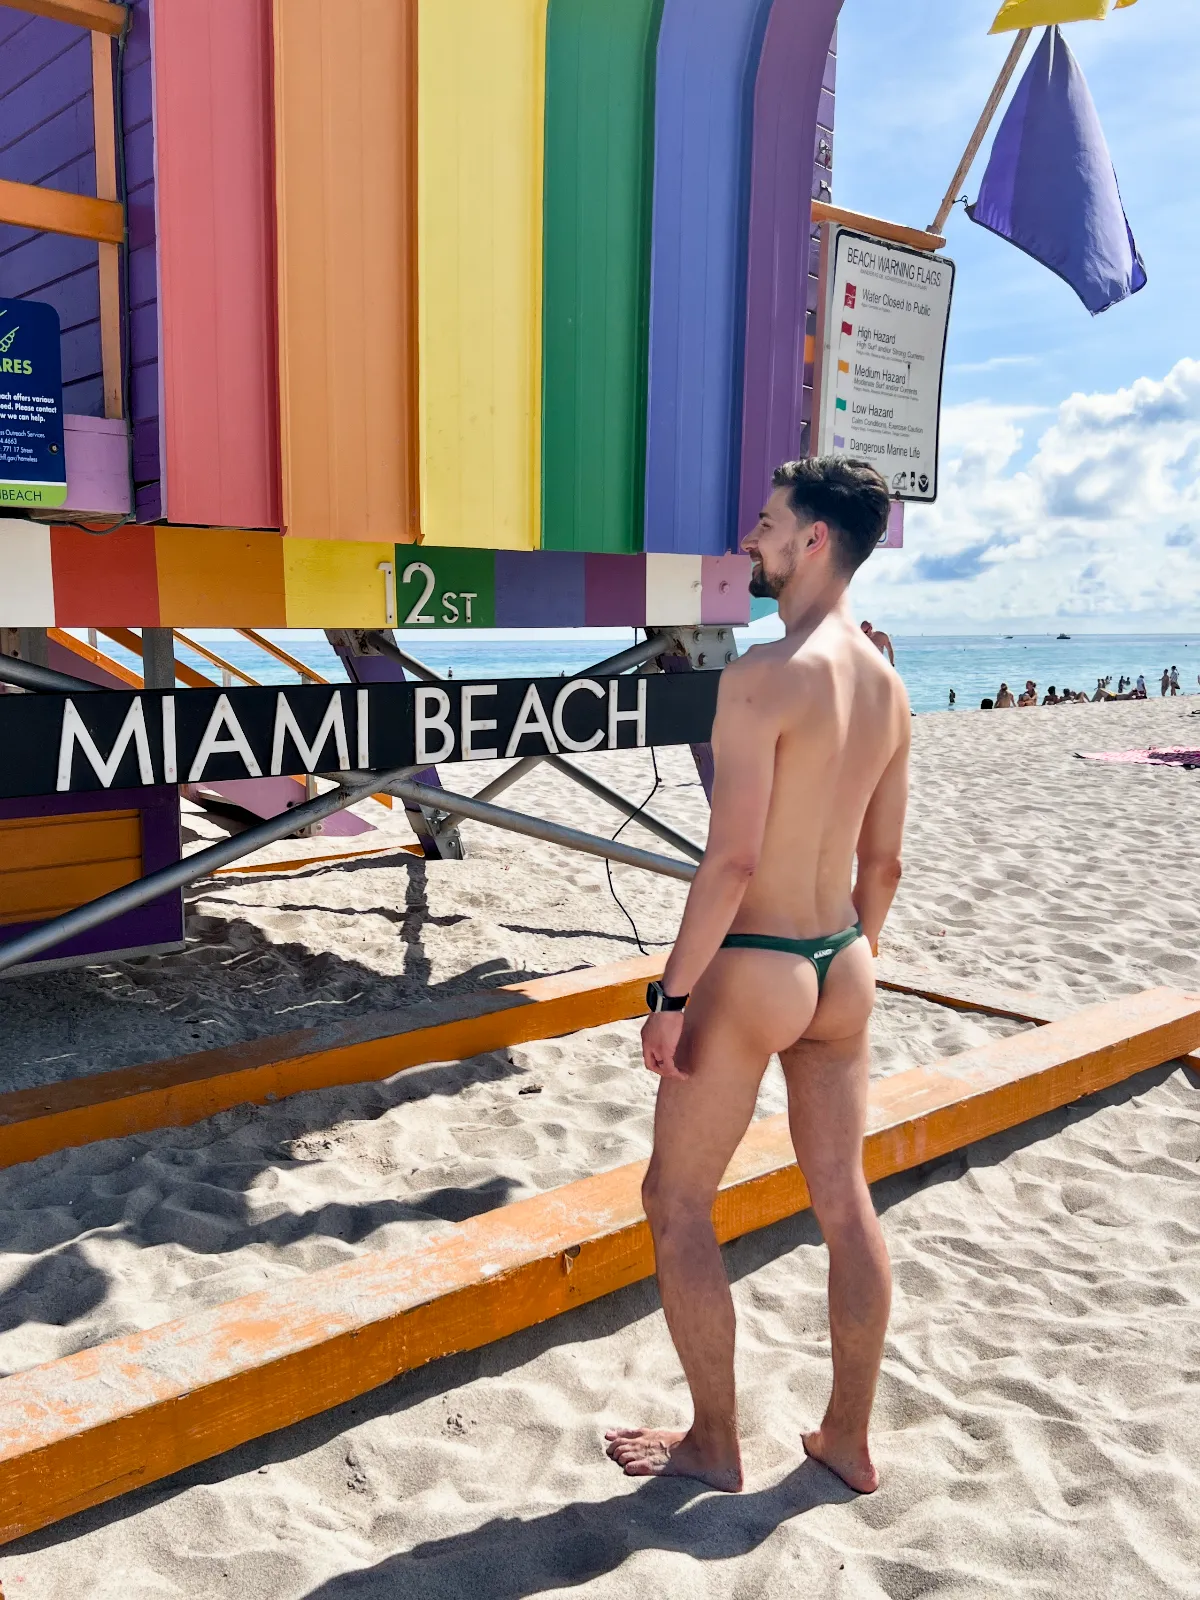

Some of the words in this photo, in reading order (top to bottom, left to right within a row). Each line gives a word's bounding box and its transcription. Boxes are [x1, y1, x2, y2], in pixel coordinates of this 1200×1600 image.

[848, 248, 876, 269] BEACH
[878, 255, 915, 280] WARNING
[916, 266, 942, 287] FLAGS
[862, 289, 882, 303] Water
[882, 293, 905, 310] Closed
[906, 299, 912, 312] to
[913, 301, 932, 317] Public
[857, 325, 872, 341] High
[873, 328, 896, 345] Hazard
[856, 340, 867, 350] High
[867, 342, 878, 351] Surf
[892, 347, 907, 359] Strong
[907, 351, 925, 361] Currents
[854, 363, 881, 380] Medium
[882, 368, 906, 385] Hazard
[853, 377, 875, 388] Moderate
[875, 381, 885, 389] Surf
[900, 385, 918, 396] Currents
[13, 392, 31, 402] offers
[32, 395, 55, 404] various
[14, 402, 35, 412] Please
[35, 405, 57, 414] contact
[852, 401, 867, 415] Low
[868, 404, 894, 419] Hazard
[30, 412, 46, 424] help.
[851, 416, 864, 425] Calm
[888, 421, 907, 432] Exercise
[907, 424, 924, 435] Caution
[5, 428, 27, 437] Outreach
[3, 445, 12, 453] 771
[20, 446, 34, 454] Street
[850, 438, 886, 455] Dangerous
[886, 443, 908, 458] Marine
[909, 446, 921, 459] Life
[377, 562, 436, 624] 12
[441, 591, 478, 624] ST
[56, 689, 370, 792] MIAMI
[414, 678, 648, 765] BEACH
